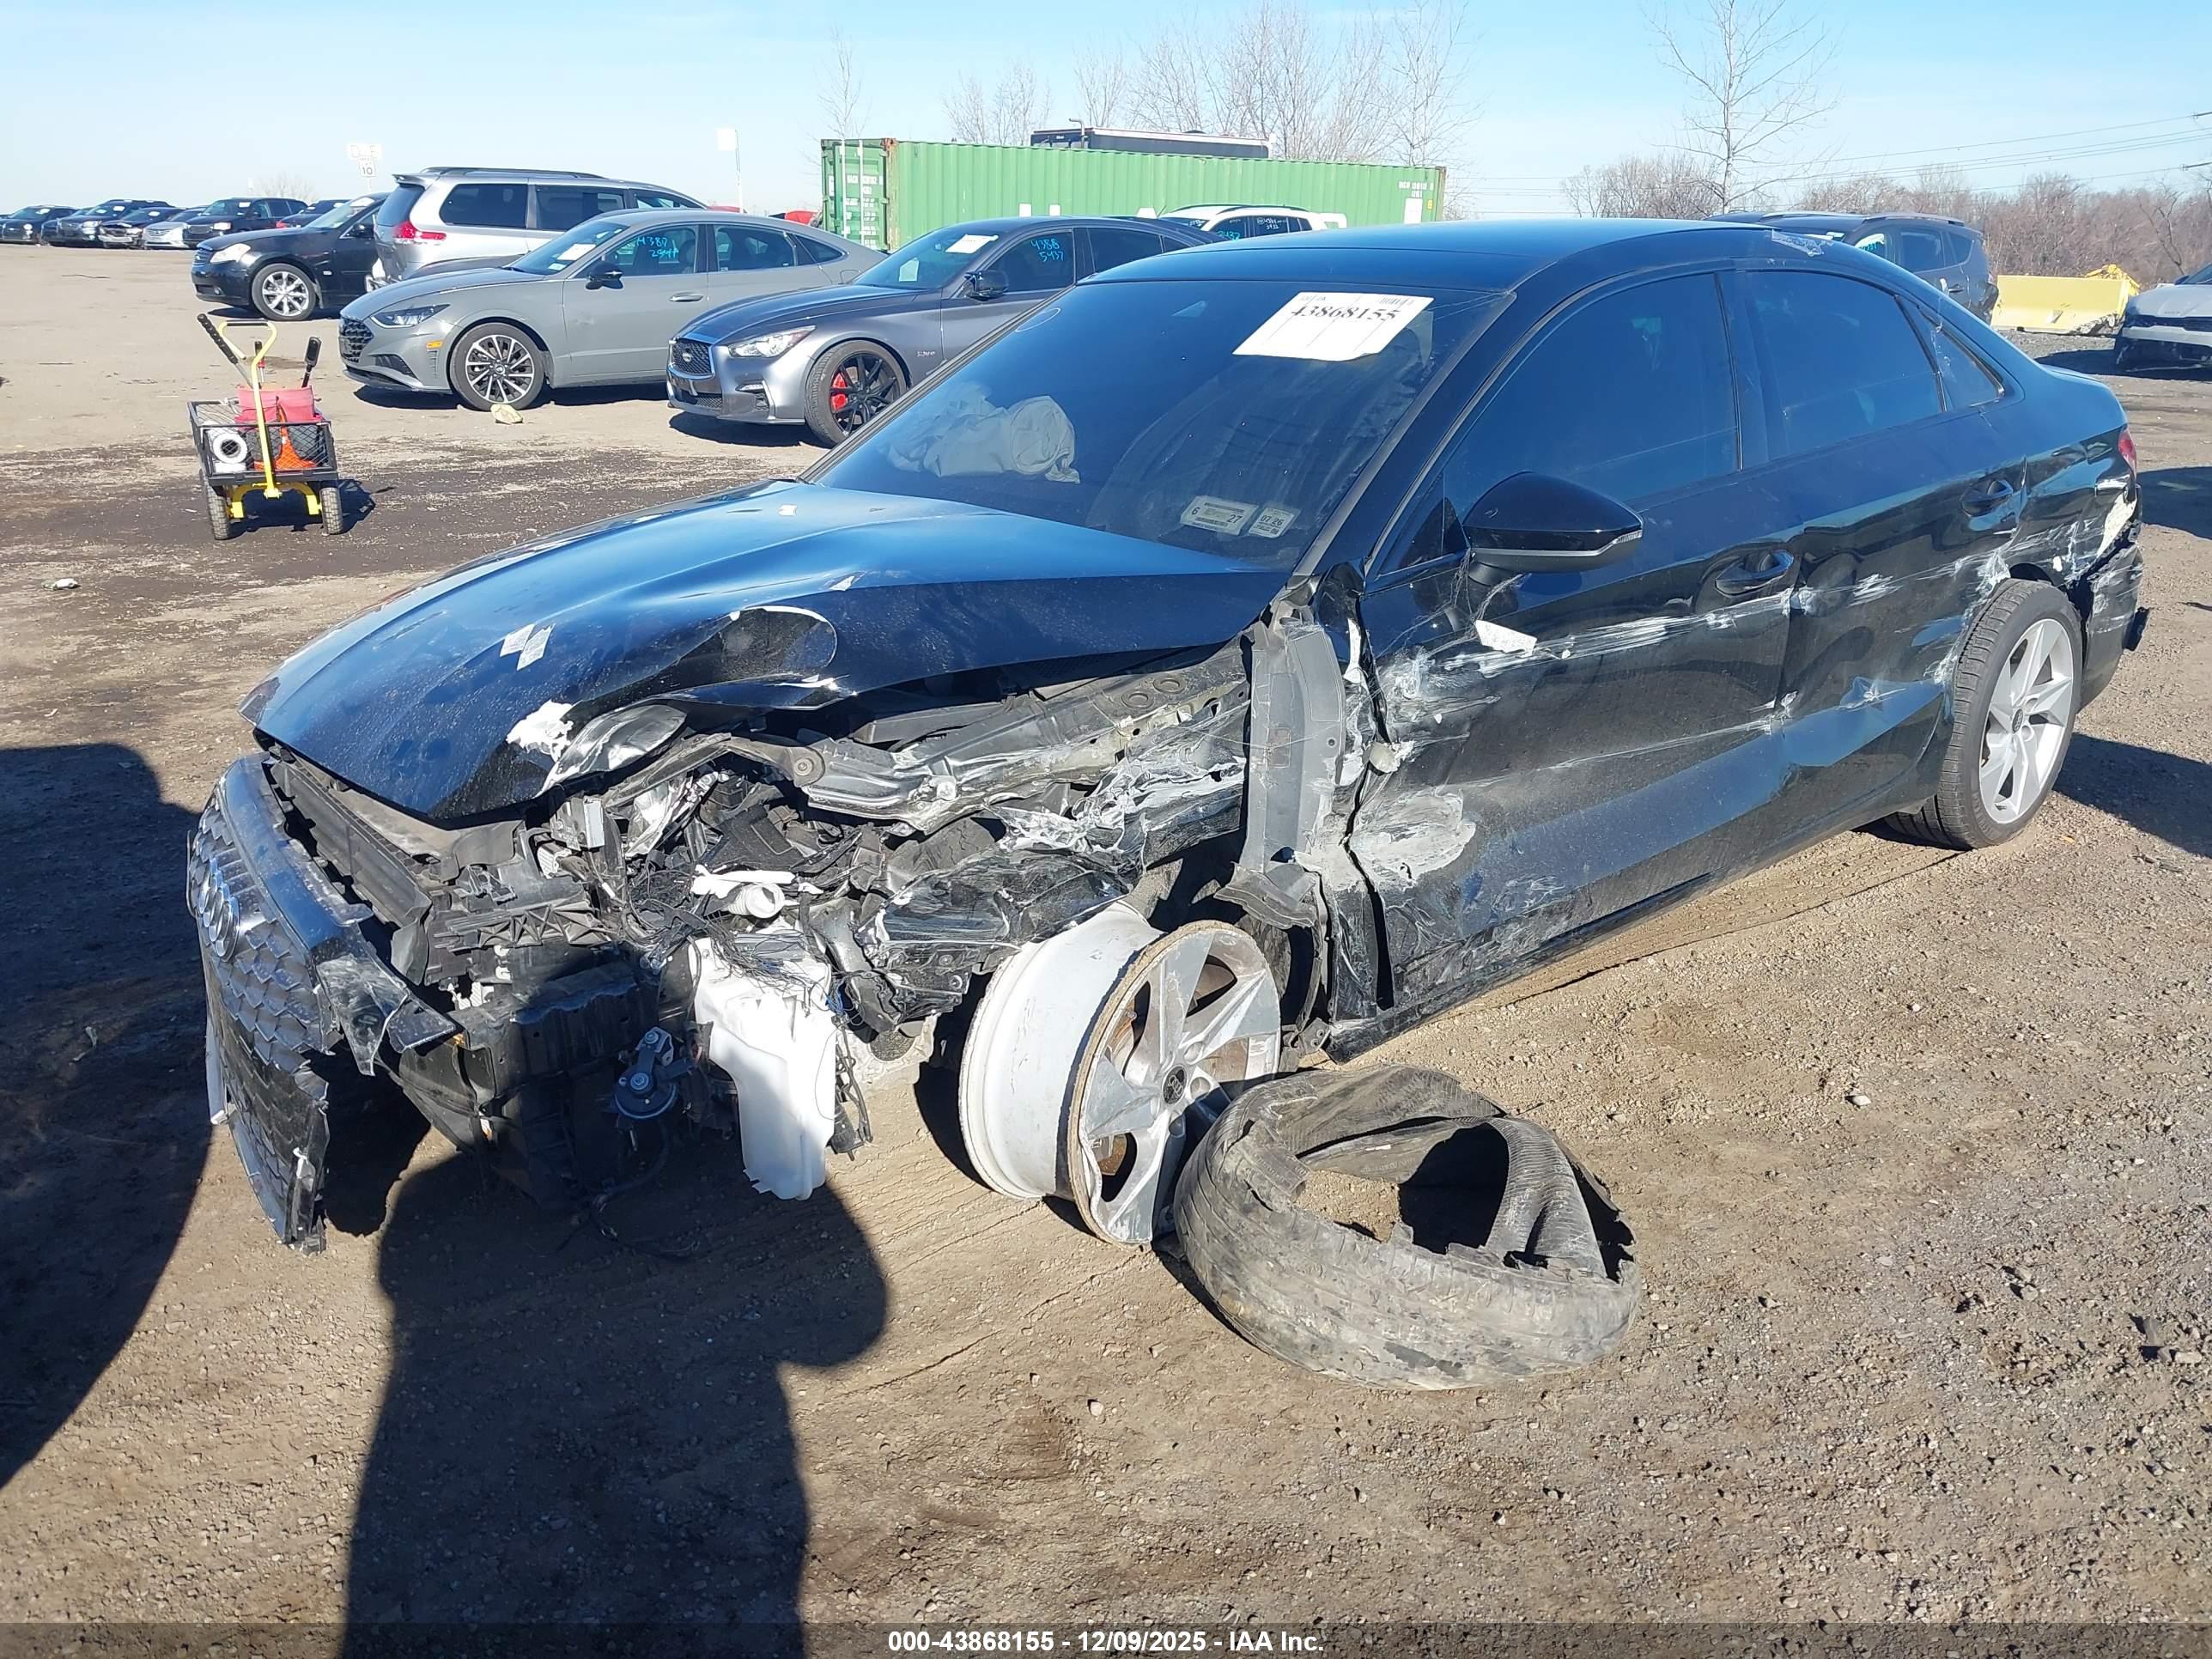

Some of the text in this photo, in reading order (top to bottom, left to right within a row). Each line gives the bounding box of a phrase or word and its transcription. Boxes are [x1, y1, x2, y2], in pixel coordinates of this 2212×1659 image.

[1291, 306, 1400, 321] 43868155
[1191, 507, 1200, 515] 6
[1227, 514, 1243, 523] 27
